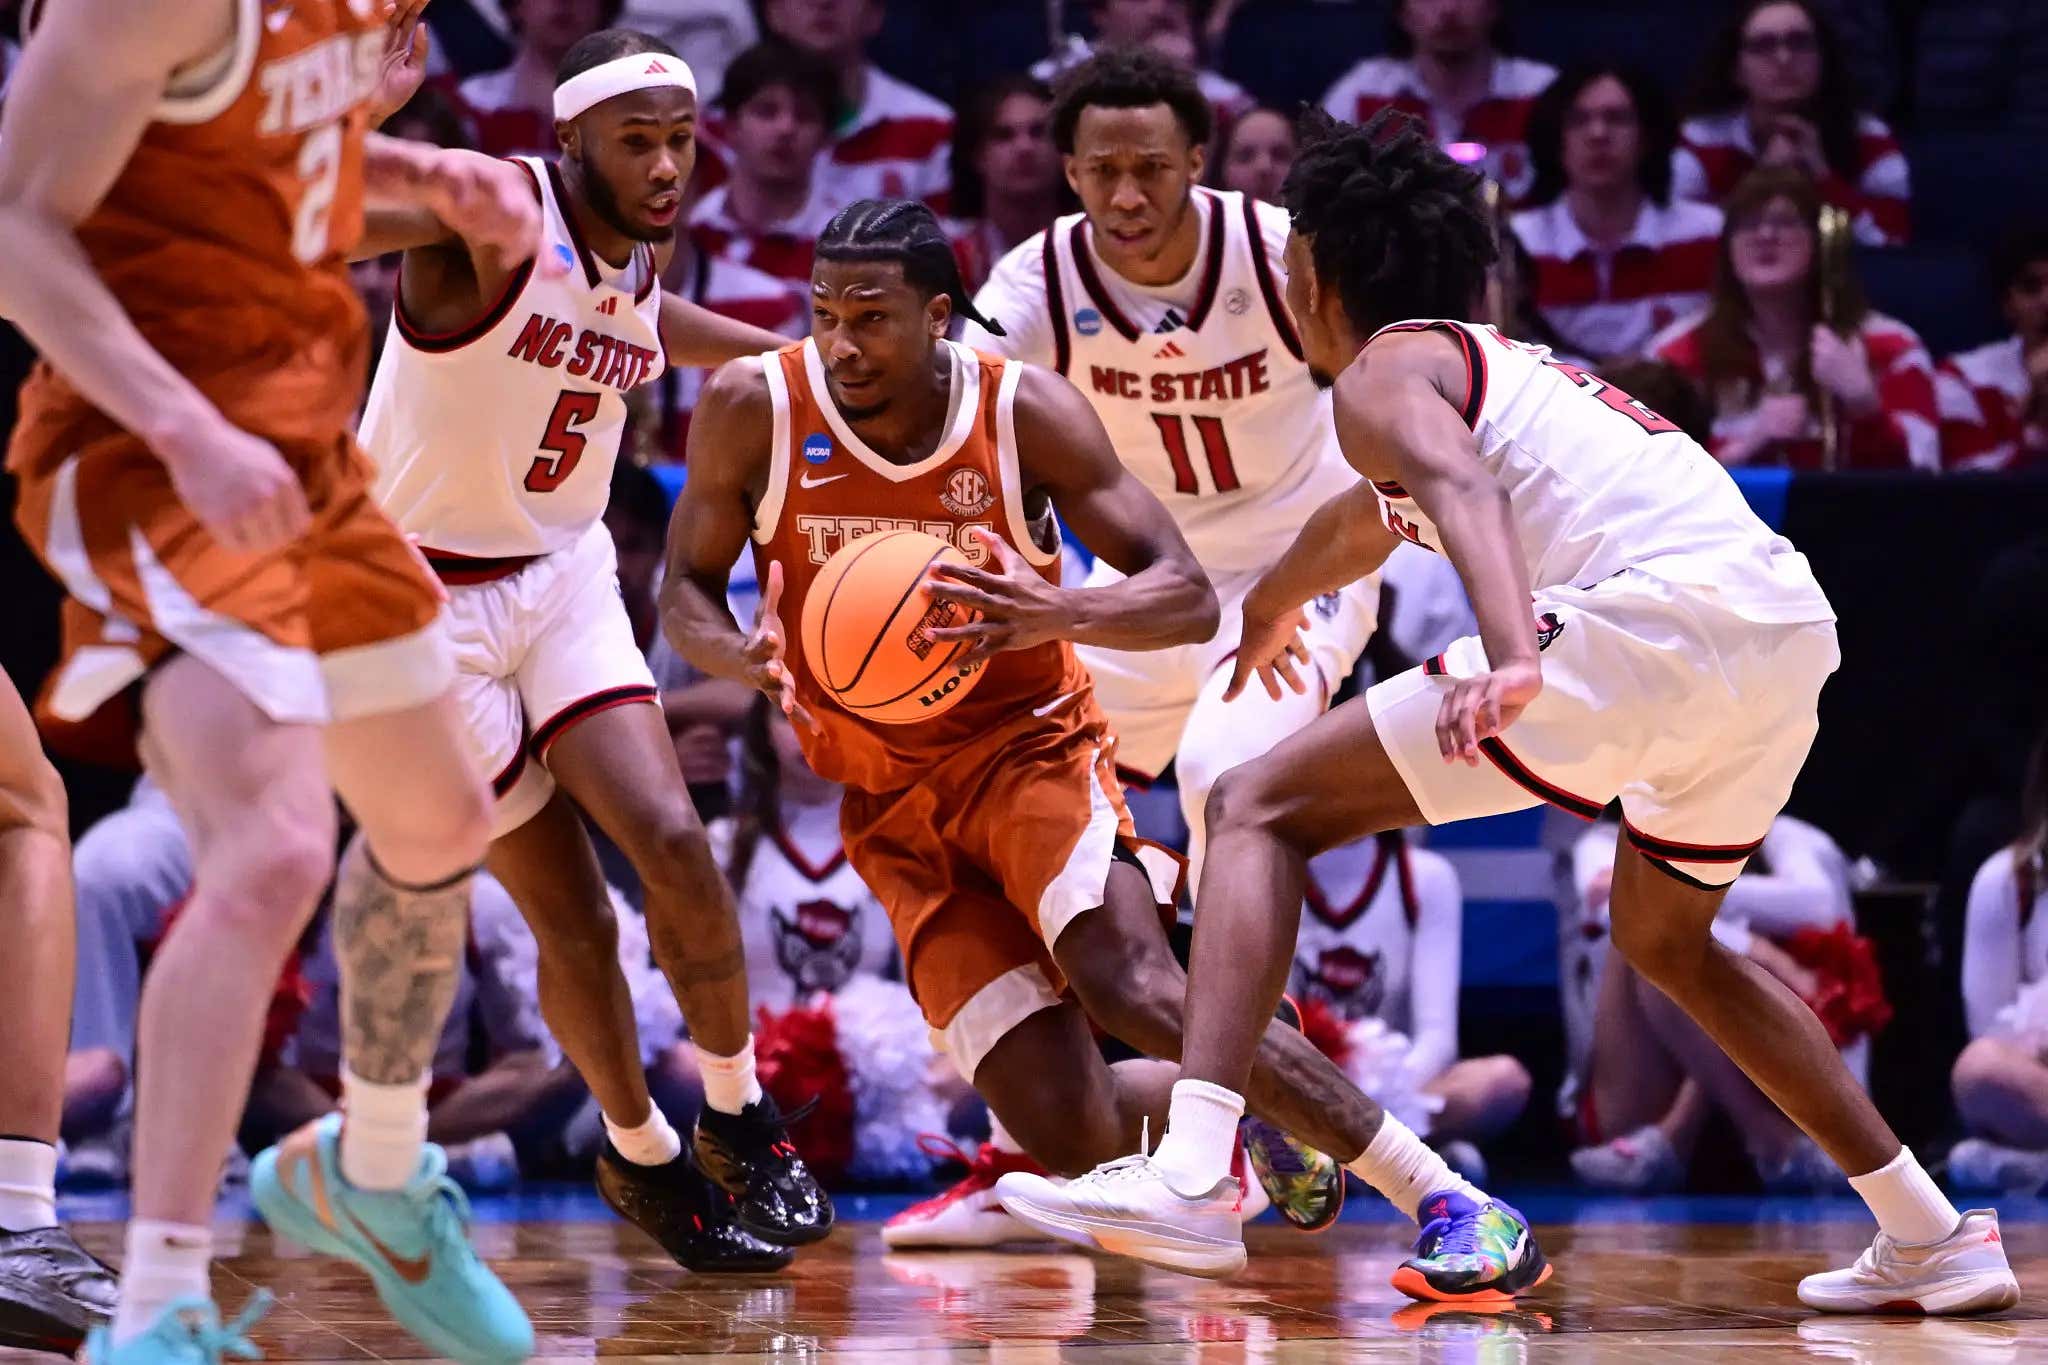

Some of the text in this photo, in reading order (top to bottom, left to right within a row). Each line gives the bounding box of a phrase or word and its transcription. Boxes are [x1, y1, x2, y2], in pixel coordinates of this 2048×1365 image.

[293, 122, 343, 267] 2
[507, 313, 658, 391] NC STATE
[1090, 348, 1270, 403] NC STATE
[524, 389, 601, 492] 5
[805, 447, 831, 456] NCAA
[1151, 412, 1241, 495] 11
[950, 471, 985, 505] SEC
